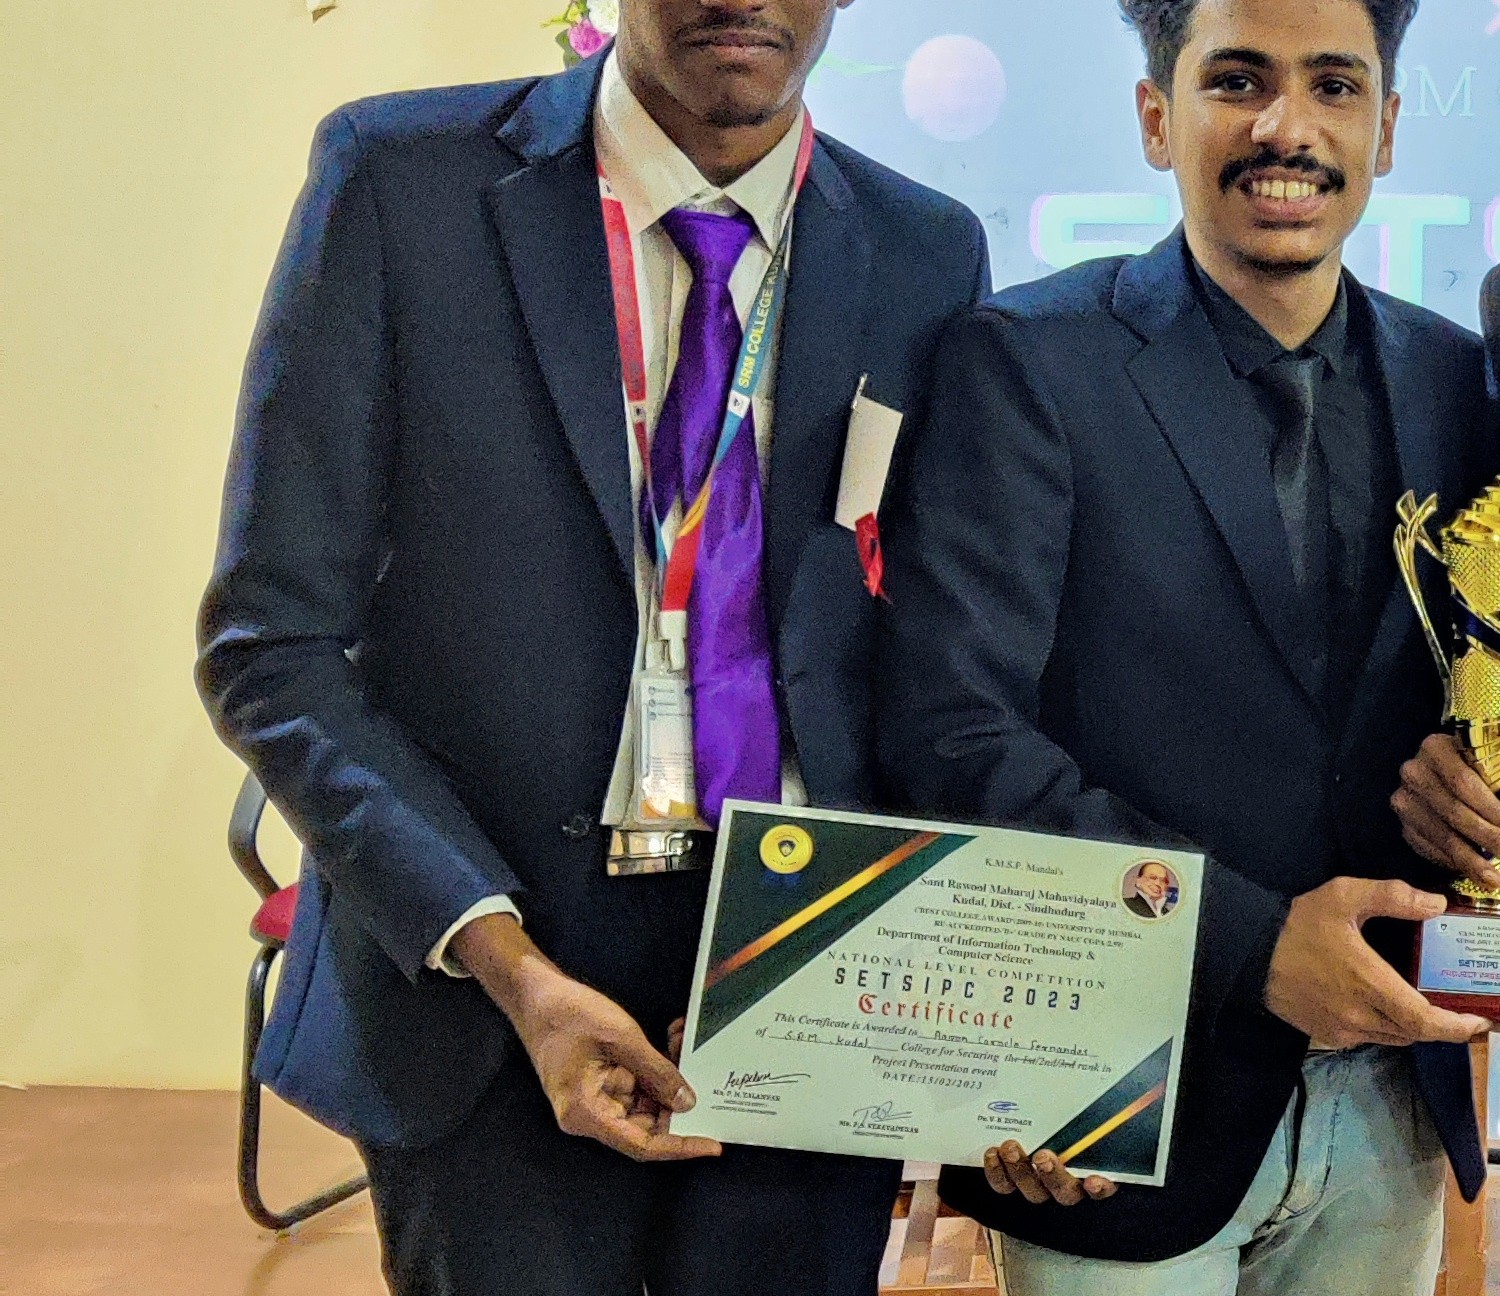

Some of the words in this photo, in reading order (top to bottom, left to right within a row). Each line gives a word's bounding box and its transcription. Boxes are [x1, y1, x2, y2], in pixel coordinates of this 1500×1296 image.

[738, 355, 756, 389] SRM
[747, 287, 774, 355] COLLEGE
[920, 877, 944, 888] Sant
[948, 879, 987, 893] Rawool
[990, 884, 1035, 900] Maharaj
[1038, 889, 1117, 910] Mahavidyalaya
[952, 894, 987, 908] Kudal,
[990, 899, 1015, 910] Dist.
[1024, 902, 1086, 920] Sindhudurg
[877, 926, 941, 943] Department
[943, 934, 955, 944] of
[957, 935, 1021, 952] Information
[1025, 943, 1082, 961] Technology
[1086, 950, 1096, 961] &
[938, 945, 993, 960] Computer
[995, 952, 1034, 965] Science
[827, 950, 915, 969] NATIONAL
[924, 961, 977, 976] LEVEL
[987, 967, 1106, 990] COMPETITION
[834, 967, 975, 999] SETSIPC
[1003, 985, 1080, 1011] 2023
[774, 1012, 795, 1024] This
[798, 1015, 850, 1030] Certificate
[852, 1020, 860, 1031] is
[863, 1018, 907, 1036] Awarded
[908, 1028, 917, 1037] to
[858, 993, 1014, 1029] Certificate
[755, 1027, 768, 1038] of
[872, 1055, 907, 1068] Project
[909, 1059, 969, 1075] Presentation
[971, 1068, 998, 1078] event
[901, 1041, 937, 1057] College
[940, 1046, 954, 1058] for
[957, 1049, 1000, 1063] Securing
[1004, 1054, 1018, 1063] the
[1078, 1061, 1099, 1072] rank
[1102, 1064, 1111, 1073] in
